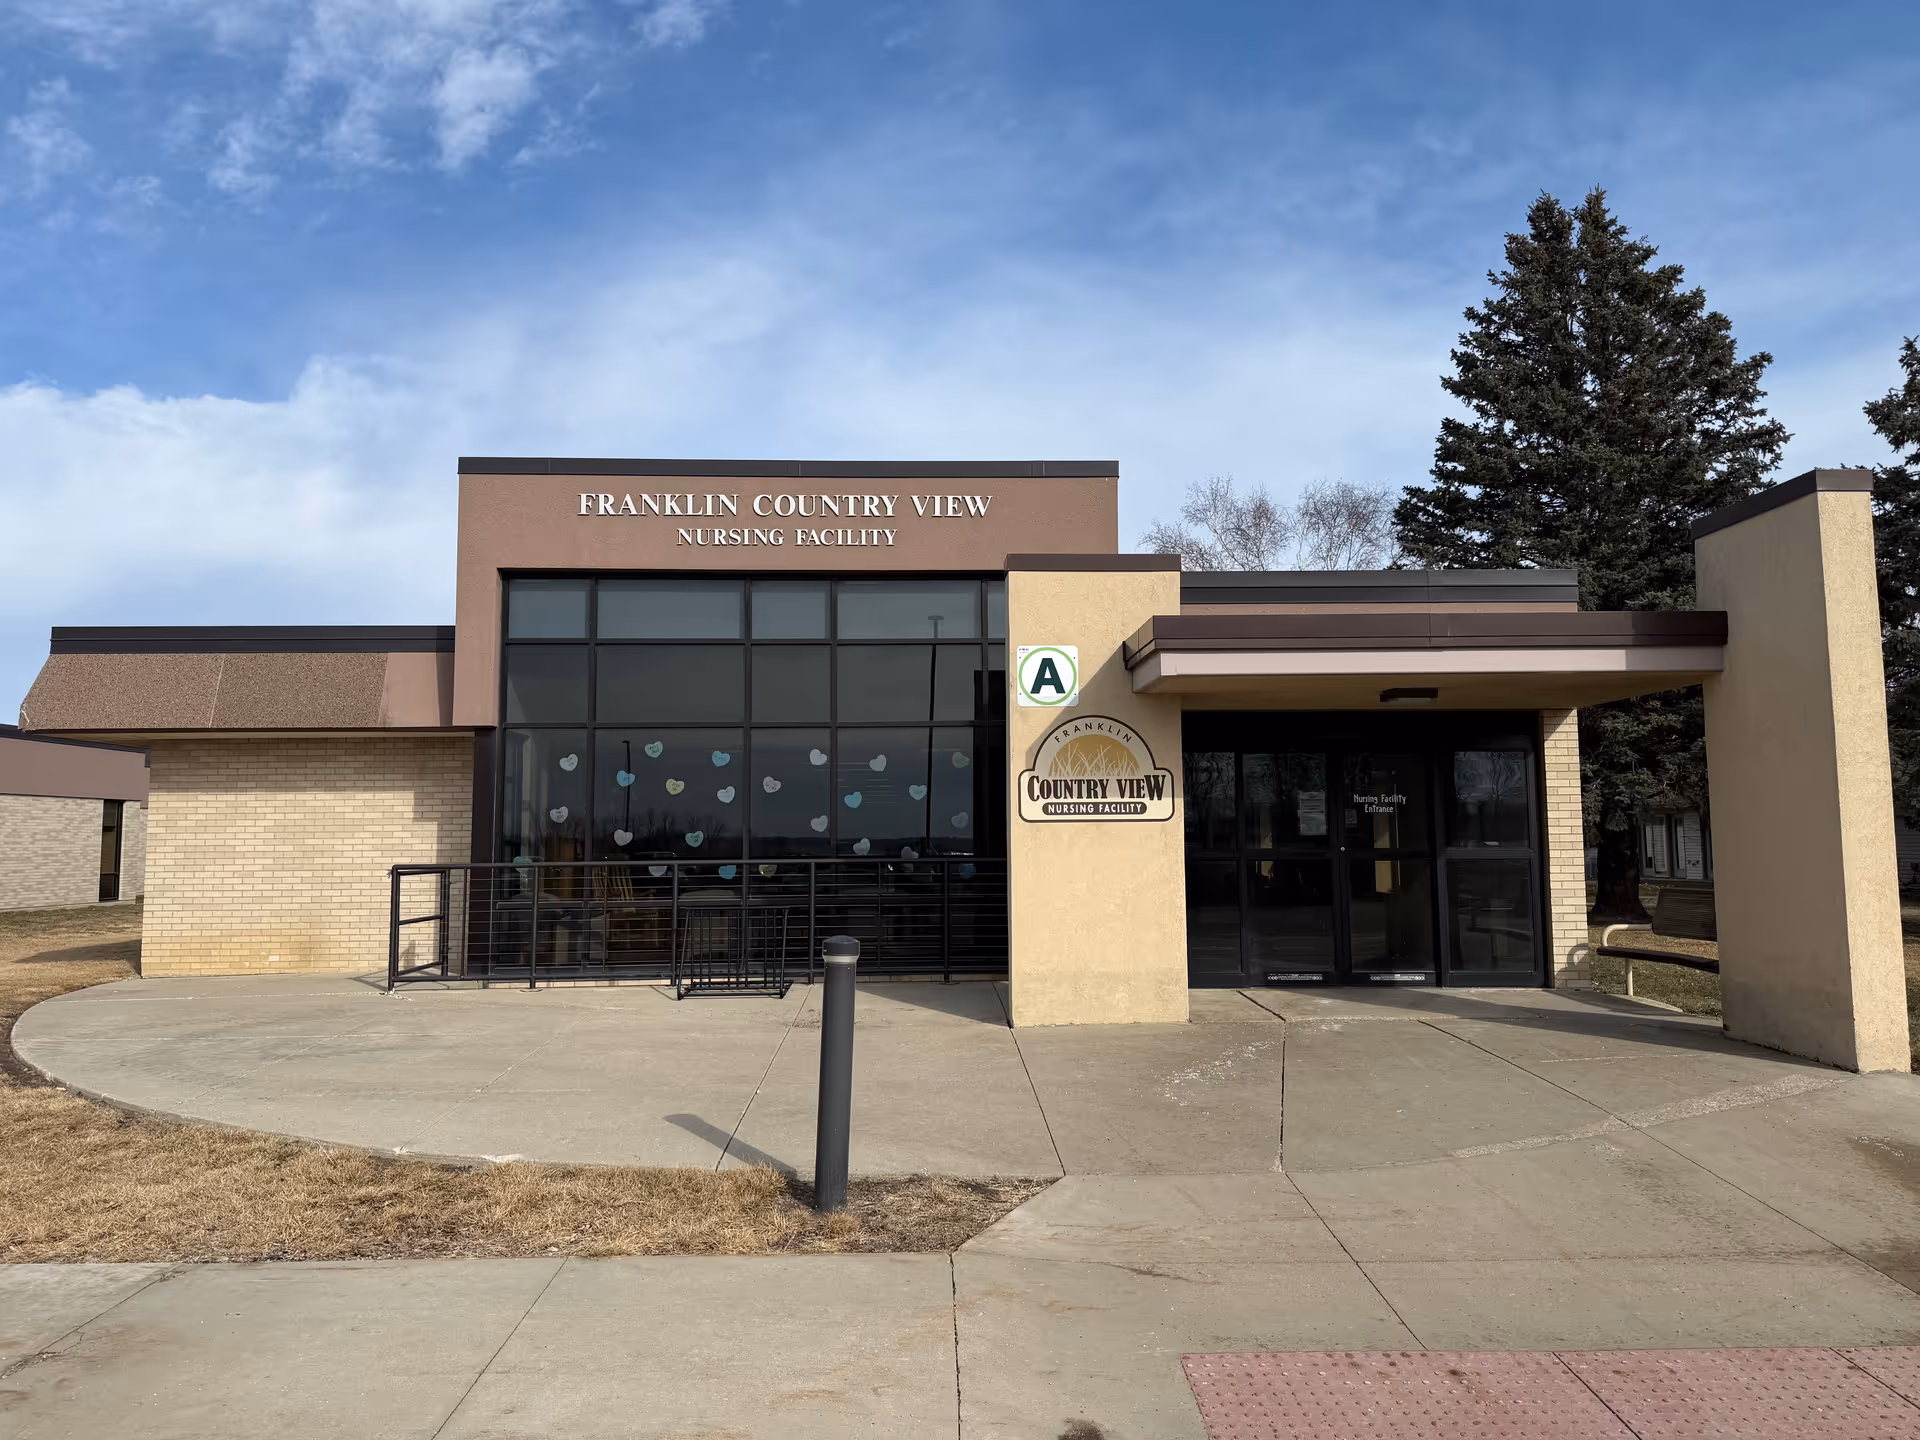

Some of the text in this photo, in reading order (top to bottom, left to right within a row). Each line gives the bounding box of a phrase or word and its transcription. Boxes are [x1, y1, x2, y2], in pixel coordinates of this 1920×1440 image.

[577, 493, 993, 517] FRANKLIN COUNTRY VIEW
[676, 528, 898, 546] NURSING FACILITY
[1030, 657, 1066, 694] A
[1054, 722, 1132, 743] FRANKLIN
[1027, 775, 1166, 802] COUNTRY VIEW
[1048, 803, 1142, 814] NURSING FACILITY
[1353, 794, 1406, 804] Nursing Facility
[1364, 803, 1394, 813] Entrance
